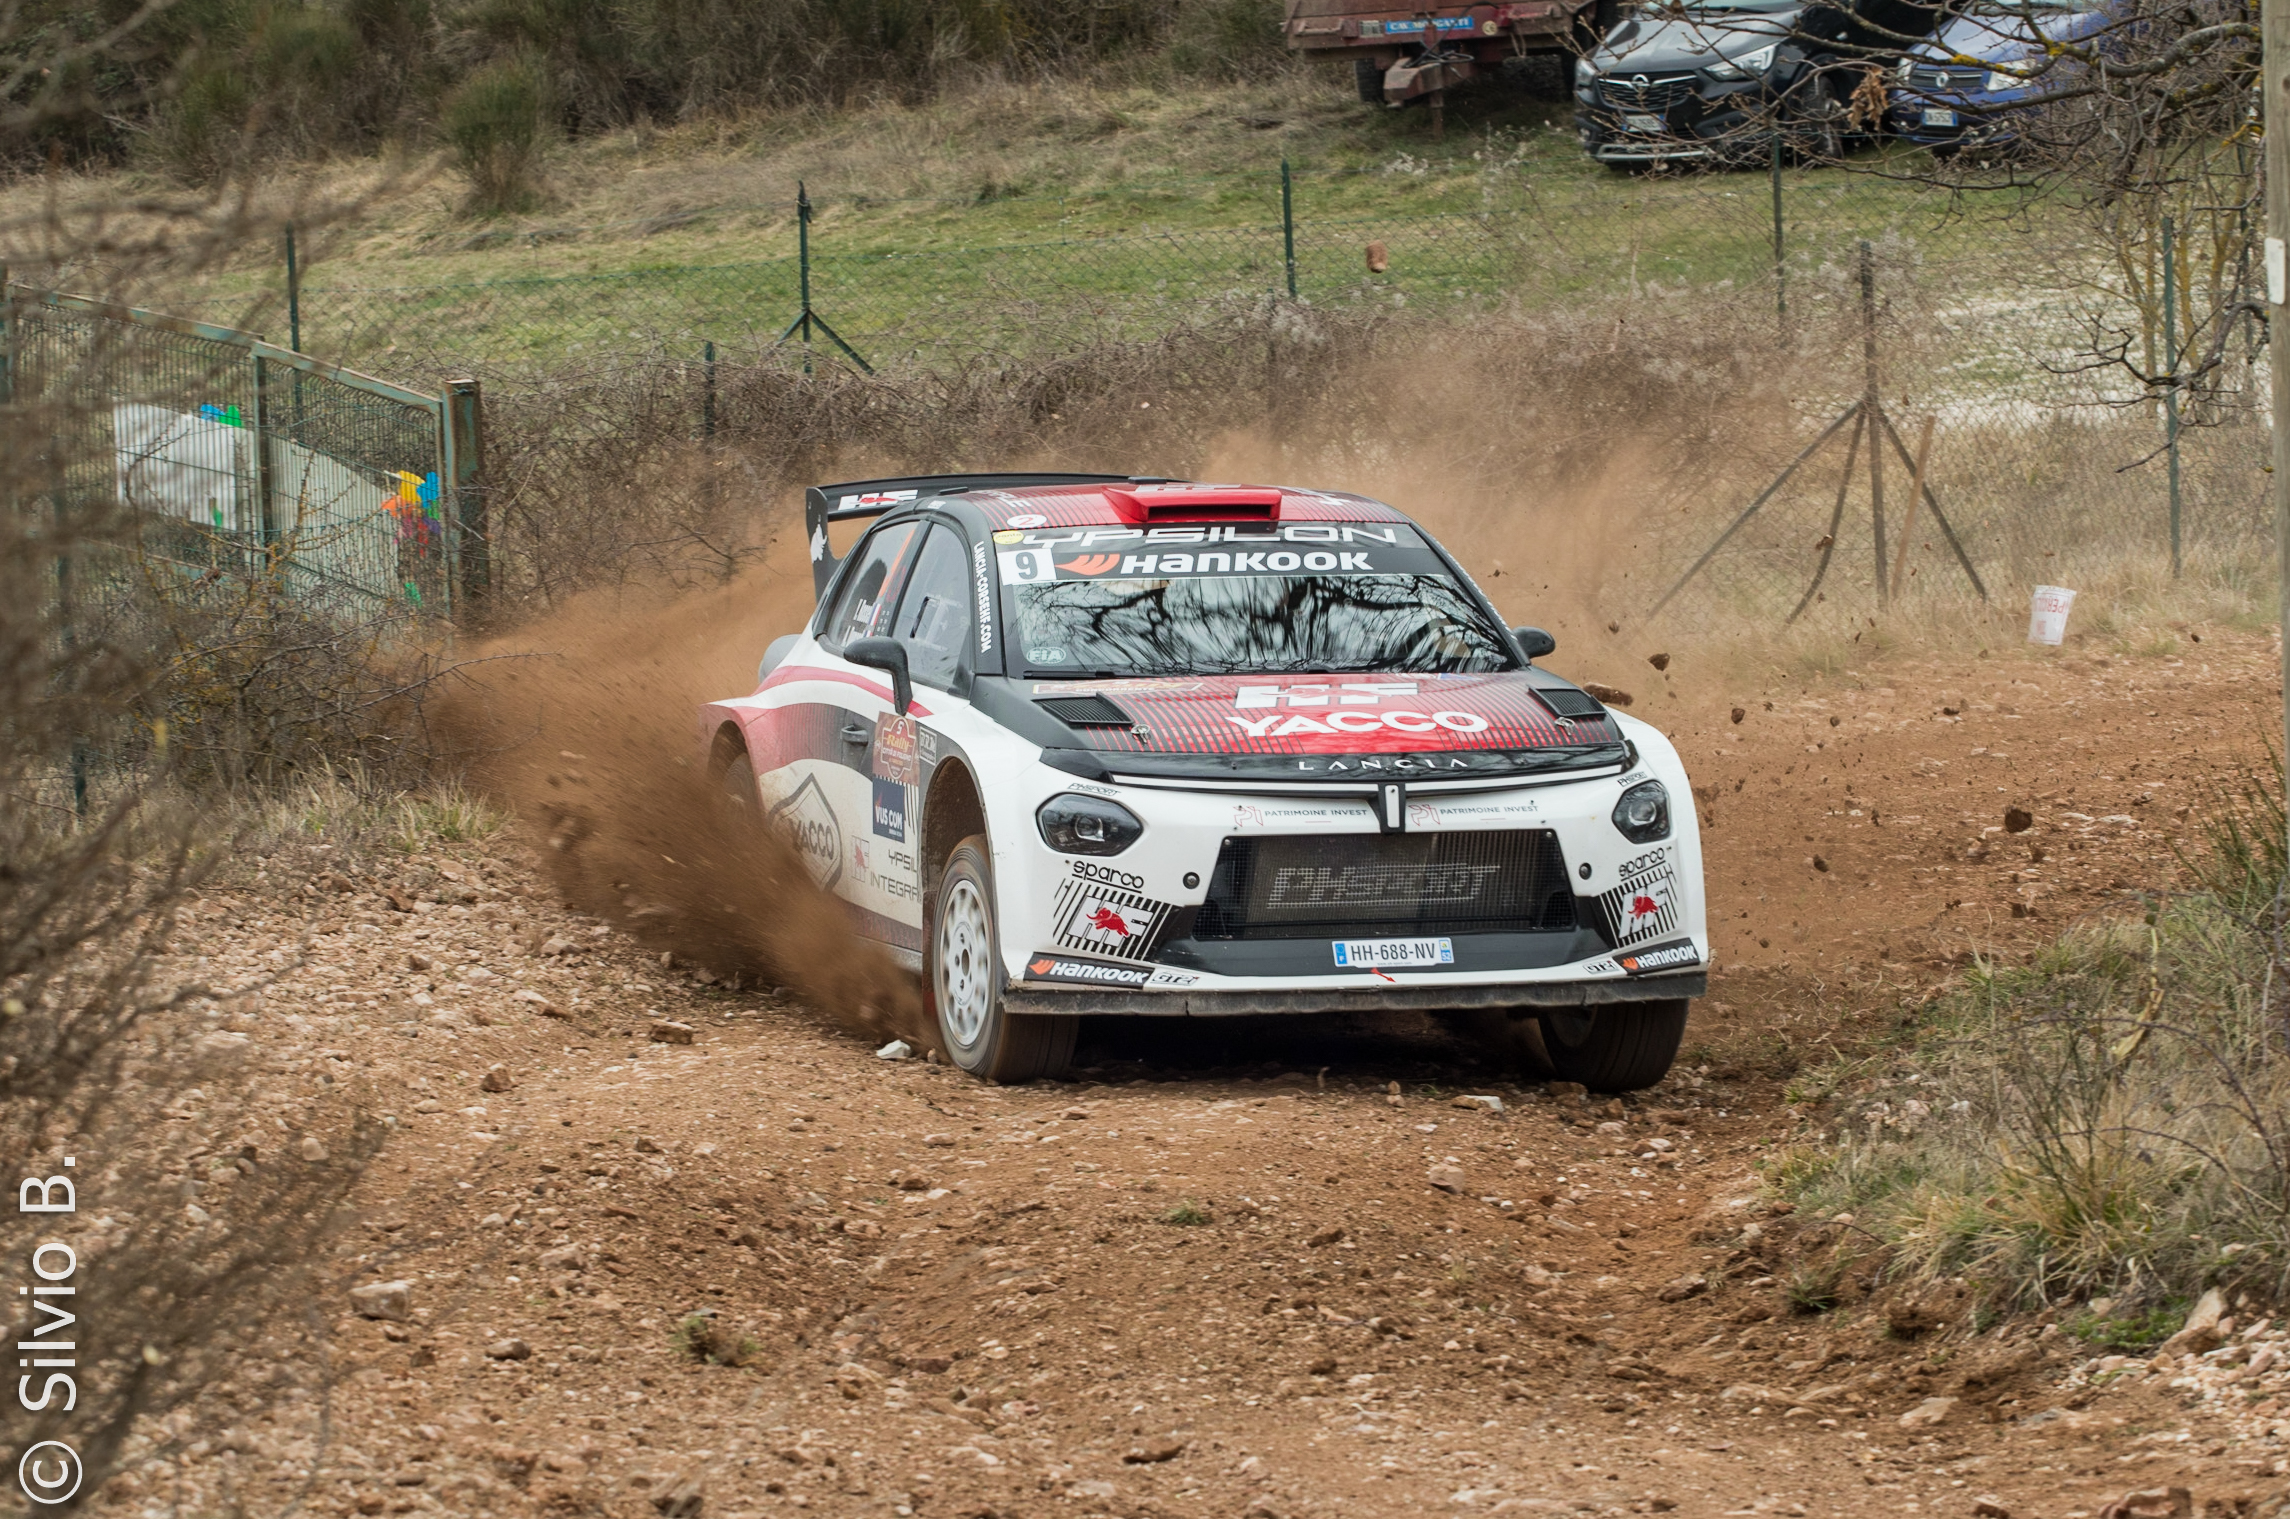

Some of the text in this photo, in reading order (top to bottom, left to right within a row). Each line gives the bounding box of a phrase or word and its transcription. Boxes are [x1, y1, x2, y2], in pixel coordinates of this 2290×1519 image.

[1022, 526, 1397, 549] YPSILON
[1015, 552, 1038, 580] 9
[1234, 682, 1418, 709] HF
[1225, 711, 1490, 737] YACCO
[887, 734, 910, 753] Rally
[1298, 758, 1469, 771] LANCIA
[875, 806, 903, 830] VUS COM
[1264, 809, 1368, 817] PATRIMOINE INVEST
[1440, 804, 1539, 816] PATRIMOINE INVEST
[788, 818, 834, 861] YACCO
[1619, 847, 1665, 878] sparco
[1072, 860, 1145, 890] sparco
[1350, 943, 1435, 961] HH-688-NV
[1442, 952, 1451, 962] 52
